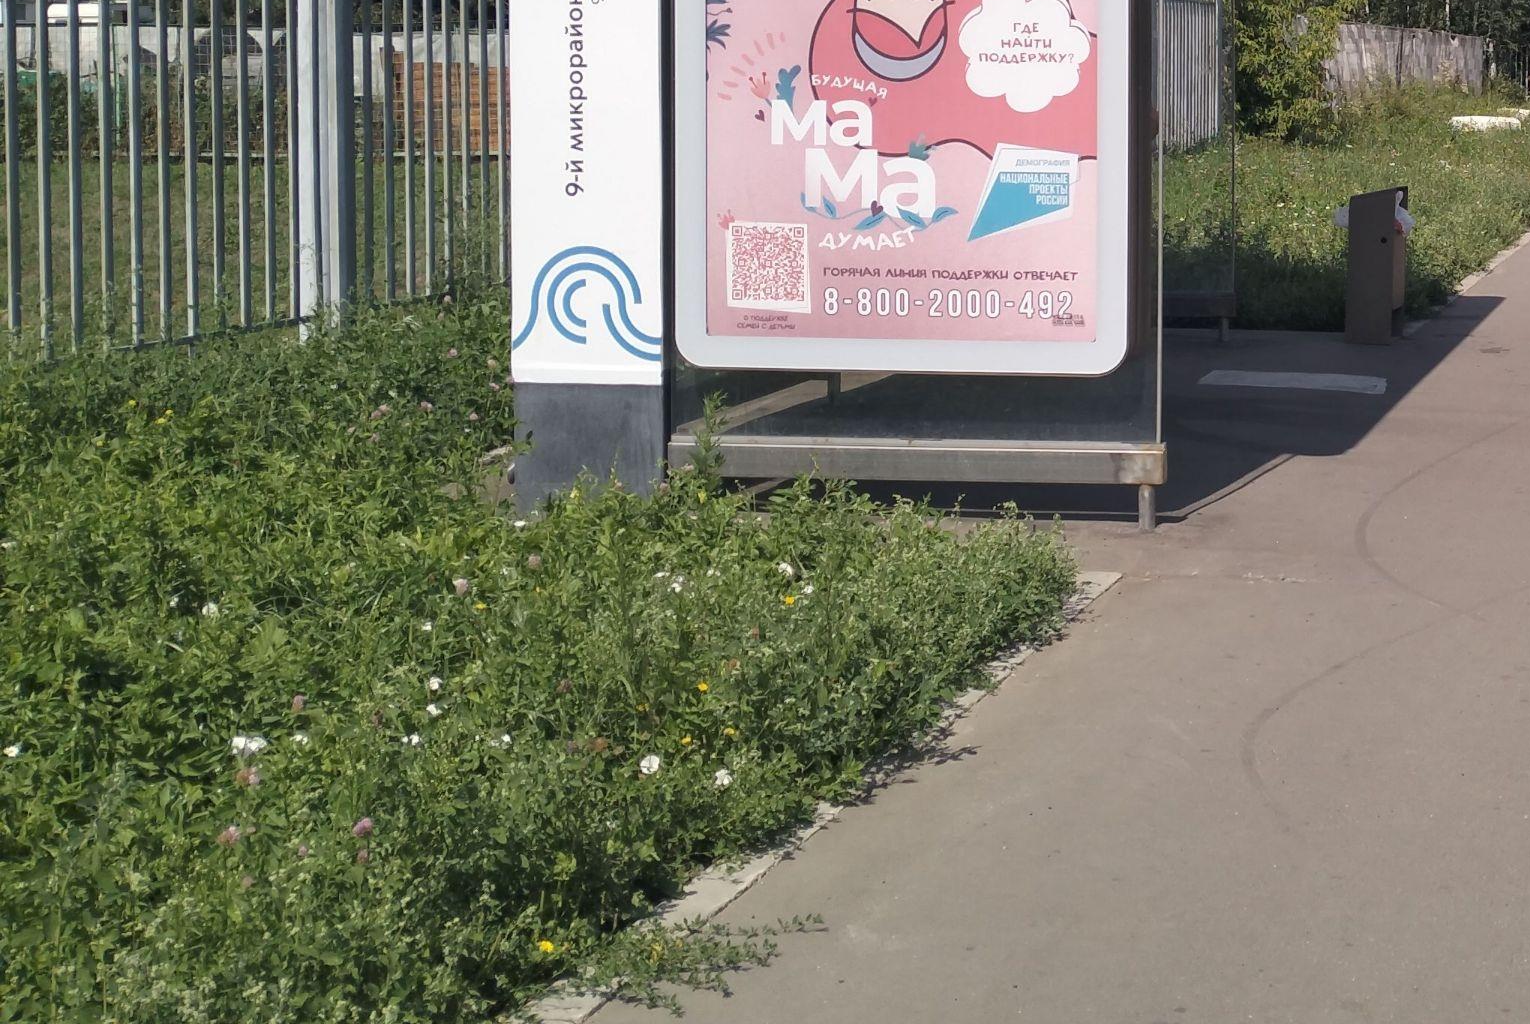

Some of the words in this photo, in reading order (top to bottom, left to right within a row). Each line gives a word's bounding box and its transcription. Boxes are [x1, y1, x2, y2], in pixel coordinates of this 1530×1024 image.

[1013, 22, 1040, 34] ГДЕ
[1000, 36, 1052, 49] НАЙТИ
[978, 52, 1075, 64] ПОДДЕРЖКУ?
[811, 74, 888, 99] БУДУЩАЯ
[1015, 158, 1071, 167] ДЕМОГРАФИЯ
[565, 160, 584, 197] 9-й
[999, 172, 1068, 184] НАЦИОНАЛЬНЫЕ
[1028, 184, 1068, 195] ПРОЕКТЫ
[1036, 195, 1068, 206] РОССИИ
[818, 226, 916, 251] ДУМАЕТ
[823, 266, 881, 277] ГОРЯЧАЯ
[885, 268, 927, 278] ЛИНИЯ
[931, 269, 1009, 281] ПОДДЕРЖКИ
[1013, 270, 1079, 281] ОТВЕЧАЕТ
[823, 286, 1073, 320] 8-800-2000-492
